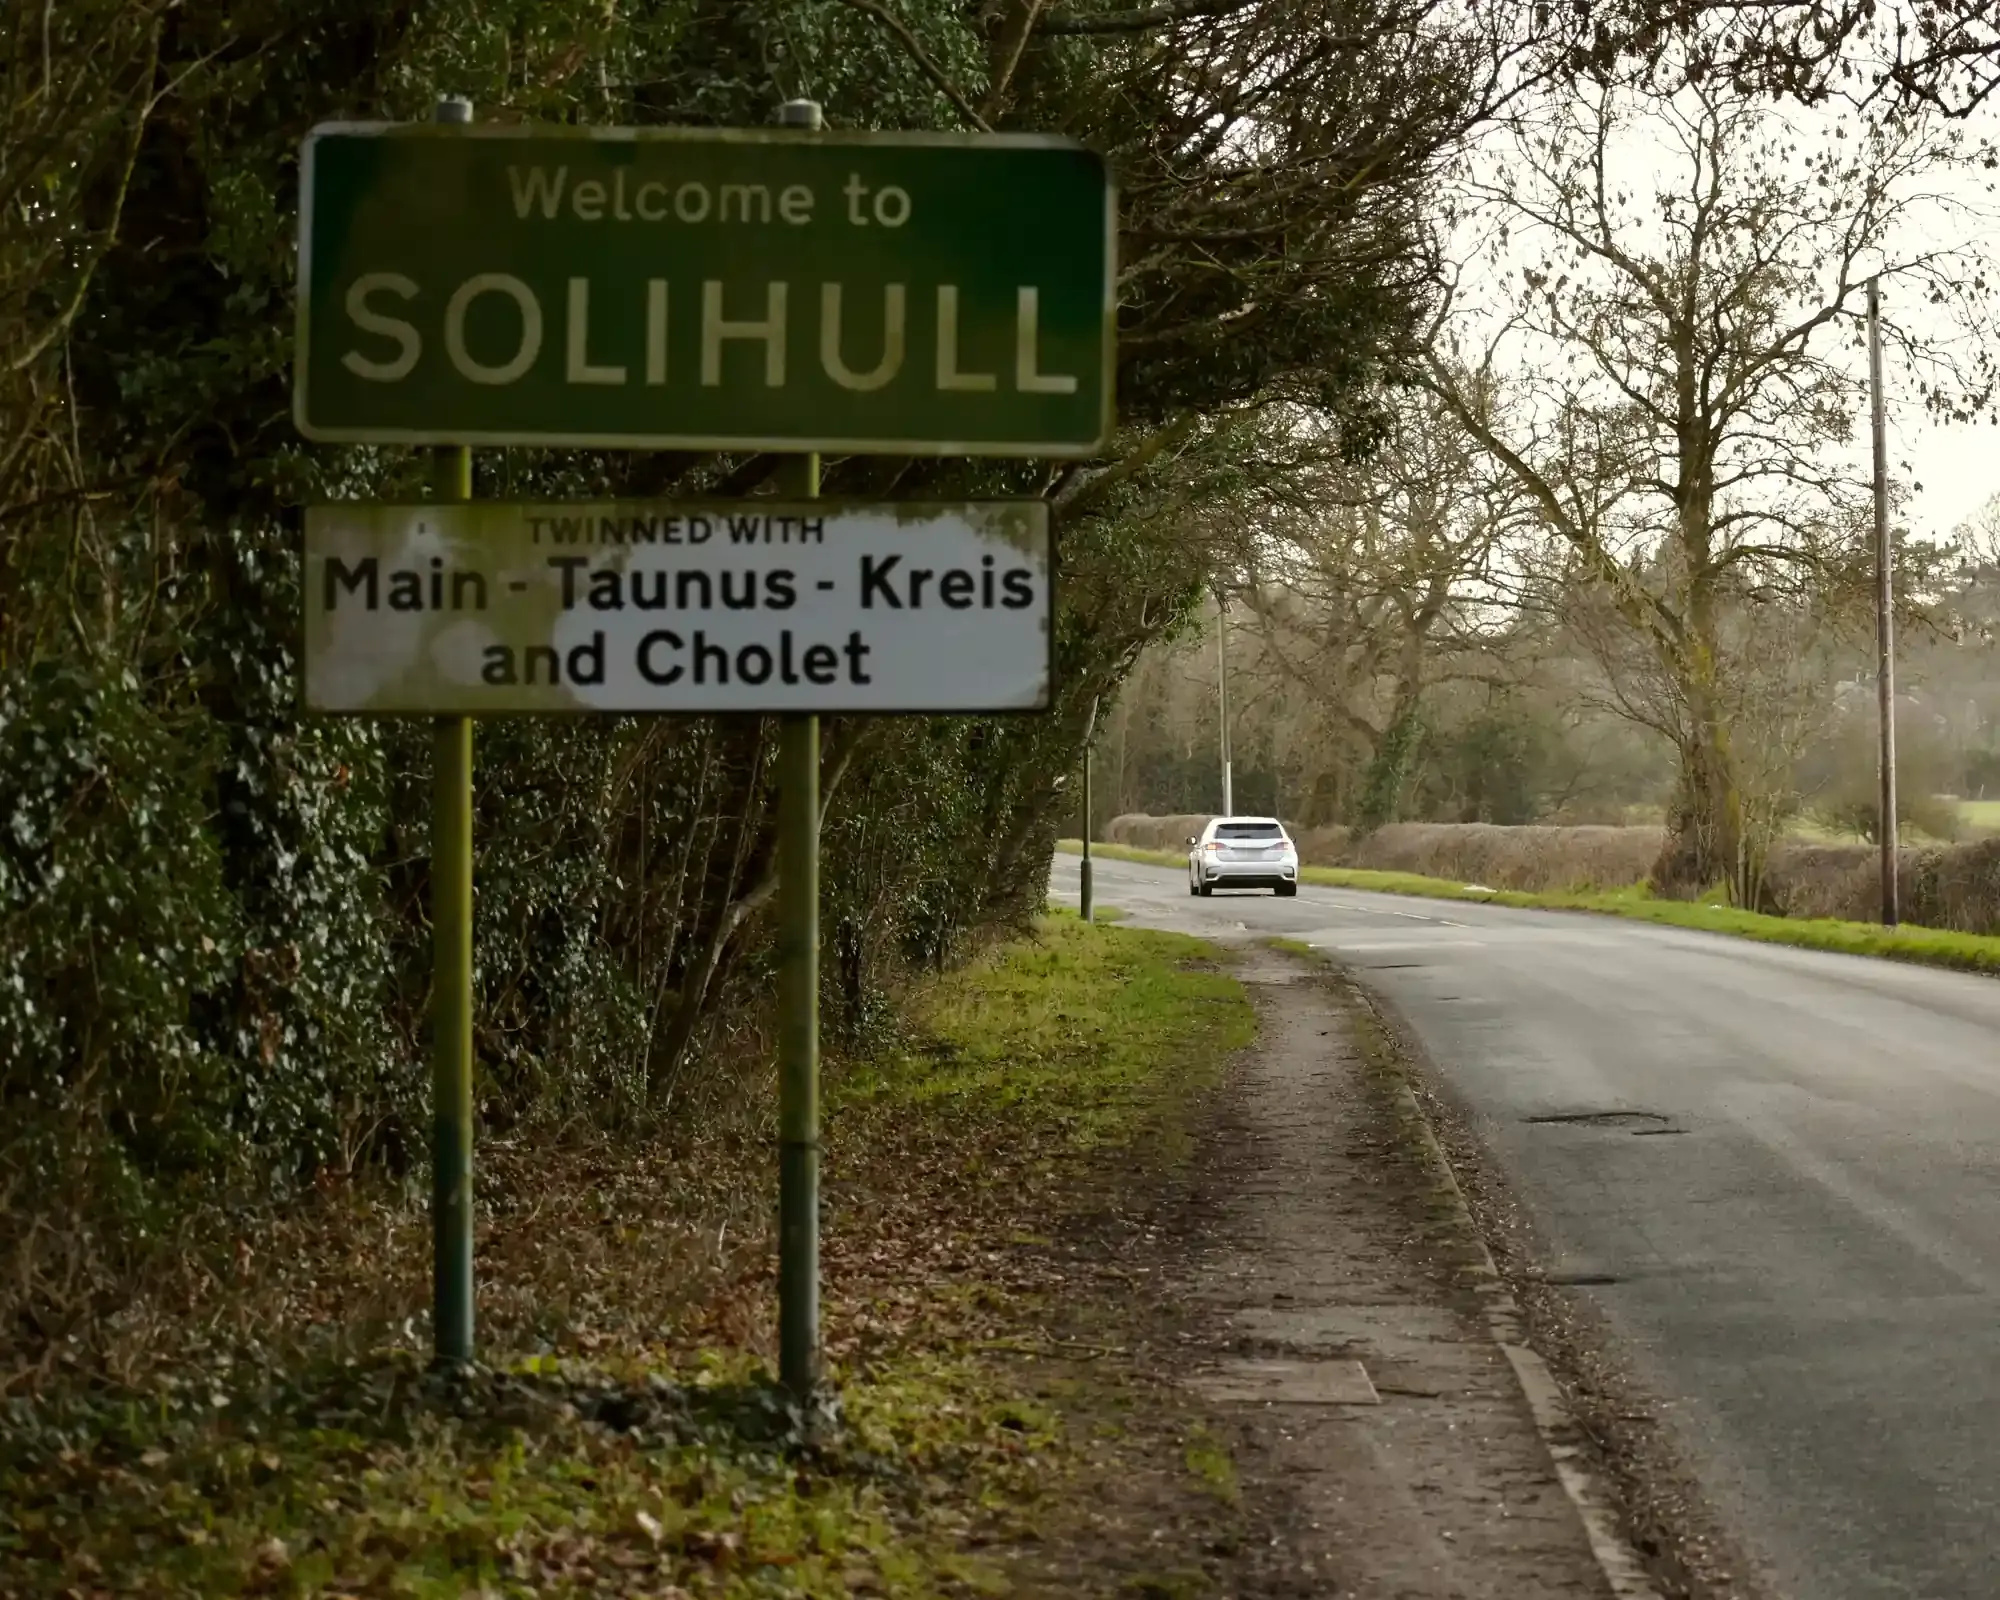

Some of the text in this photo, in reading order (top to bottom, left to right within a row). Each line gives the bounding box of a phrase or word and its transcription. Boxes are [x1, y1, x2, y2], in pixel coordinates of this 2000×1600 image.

[508, 165, 912, 227] Welcome to
[341, 273, 1079, 394] SOLIHULL
[529, 516, 825, 545] TWINNED WITH
[323, 557, 488, 611] Main
[548, 556, 798, 610] Taunus
[860, 555, 1035, 609] Kreis
[481, 630, 872, 686] and Cholet
